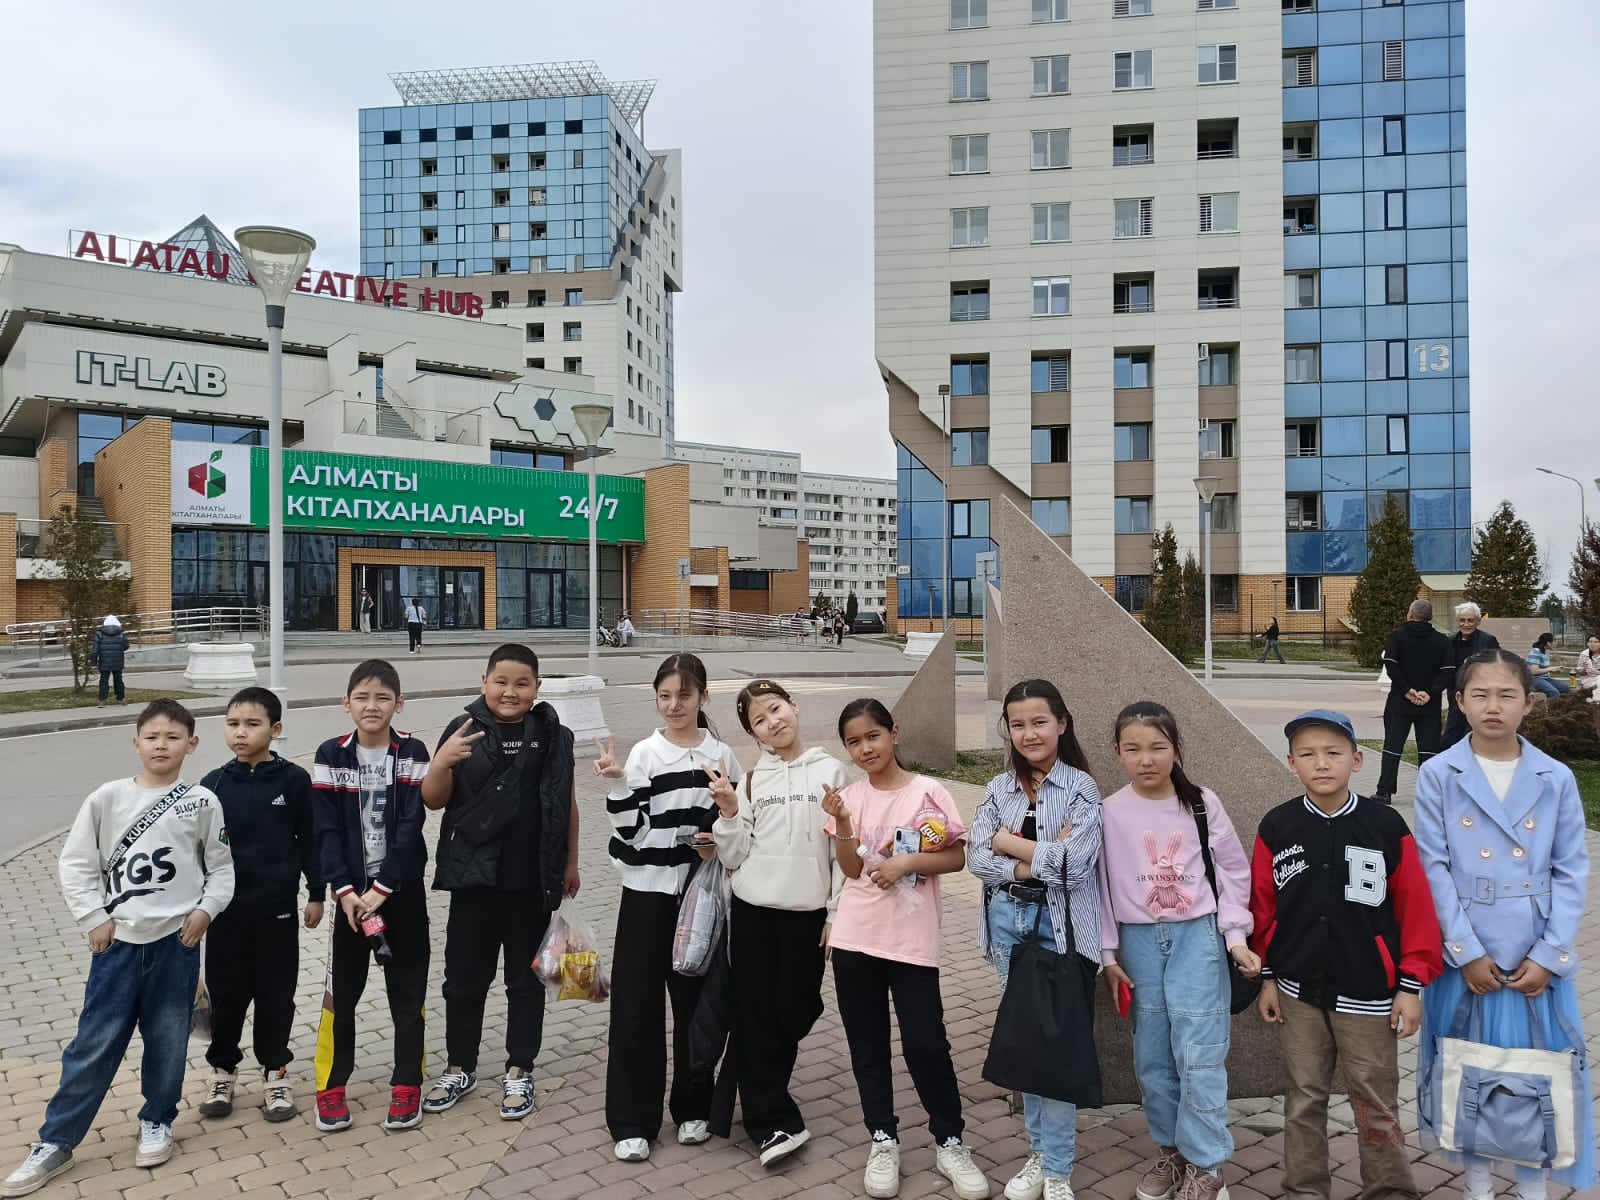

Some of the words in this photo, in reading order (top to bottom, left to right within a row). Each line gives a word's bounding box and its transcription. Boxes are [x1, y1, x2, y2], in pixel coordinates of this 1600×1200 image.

[75, 231, 229, 280] ALATAU
[249, 262, 408, 308] EATIVE
[423, 286, 484, 318] HUB
[76, 350, 227, 397] IT-LAB
[1413, 343, 1450, 373] 13
[288, 463, 418, 493] АЛМАТЫ
[286, 495, 526, 529] КІТАПХАНАЛАРЫ
[559, 493, 619, 521] 24/7
[1344, 845, 1387, 907] B
